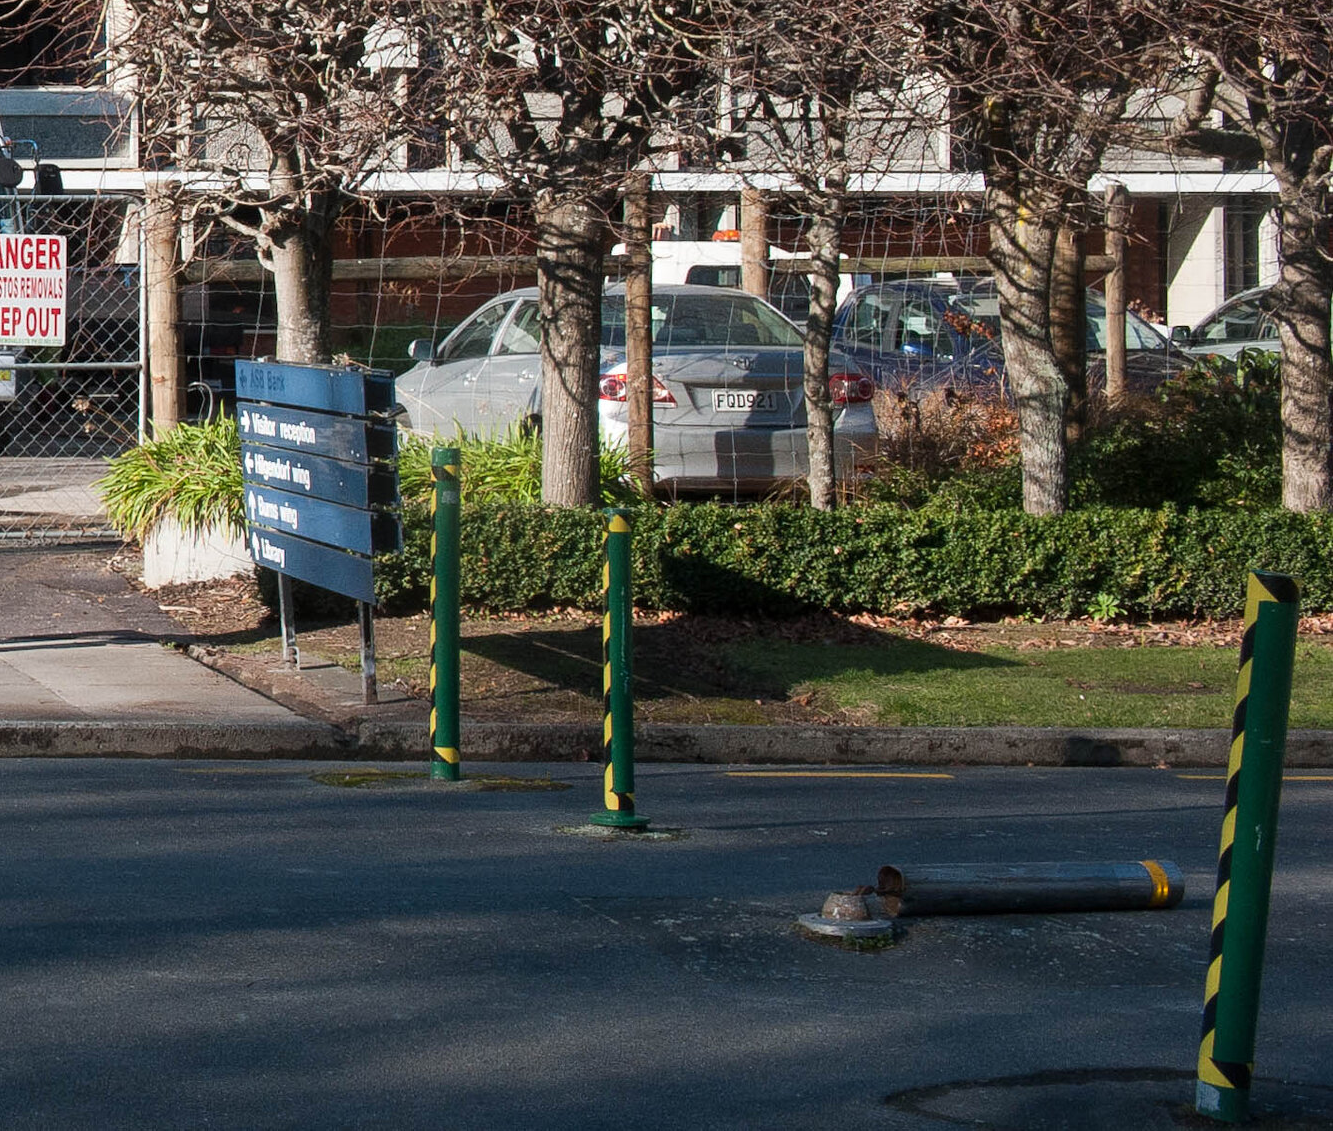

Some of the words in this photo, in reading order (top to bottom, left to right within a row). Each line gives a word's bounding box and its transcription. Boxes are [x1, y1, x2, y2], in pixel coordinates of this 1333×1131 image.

[20, 277, 63, 299] REMOVALS
[26, 307, 61, 337] OUT
[250, 369, 265, 388] ASB
[717, 394, 773, 408] FQD921
[252, 412, 276, 437] Visitor
[279, 421, 316, 446] reception
[291, 462, 311, 491] wing
[279, 502, 298, 530] wing
[261, 537, 285, 569] Library
